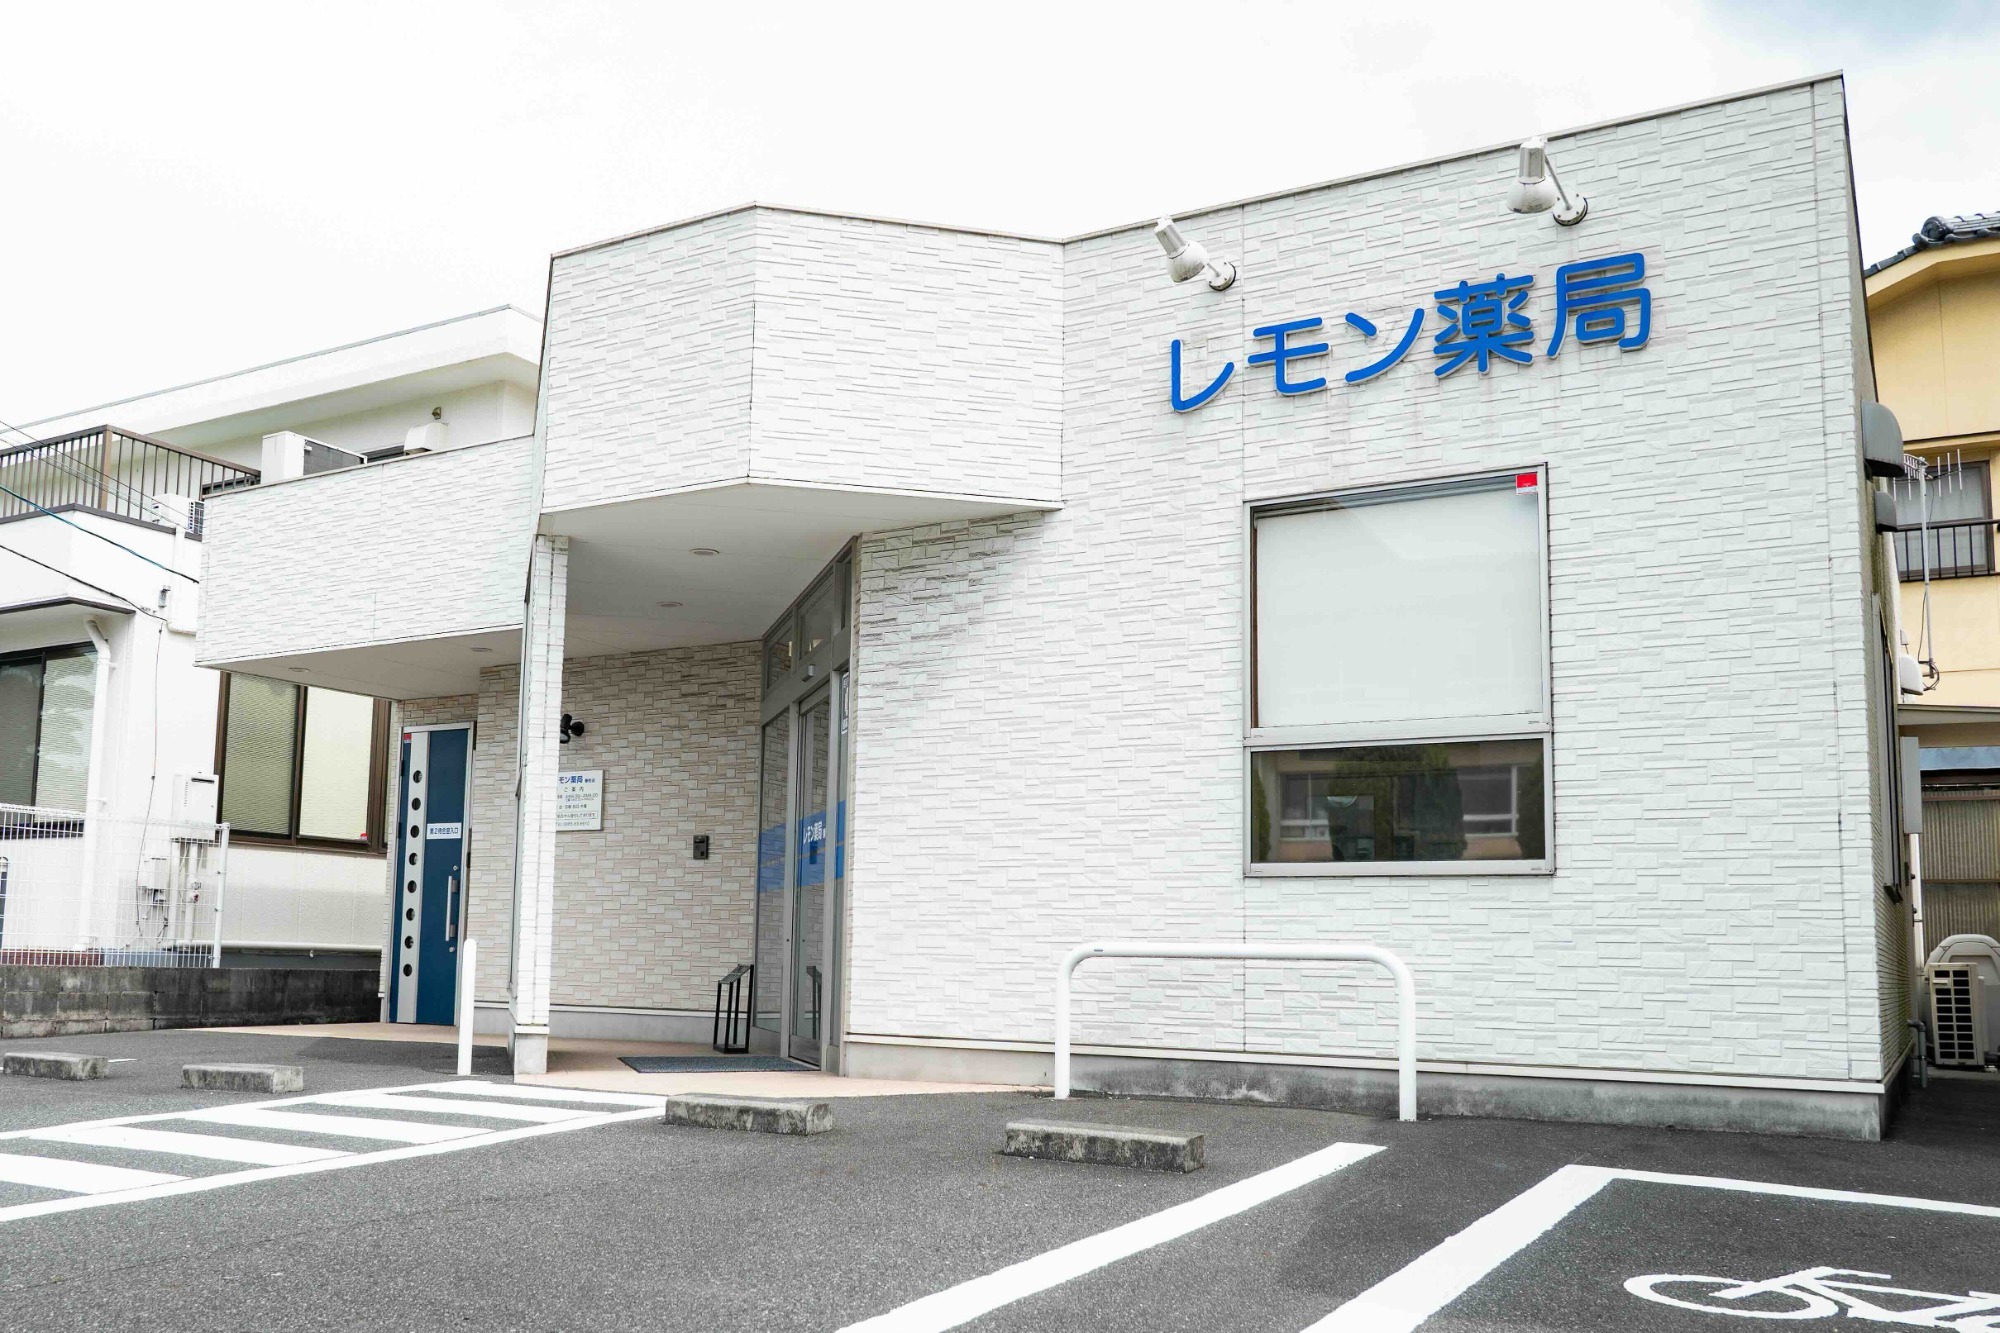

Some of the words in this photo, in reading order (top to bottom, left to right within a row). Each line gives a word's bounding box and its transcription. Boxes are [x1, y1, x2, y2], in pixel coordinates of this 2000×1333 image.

[1171, 252, 1651, 413] レモン薬局
